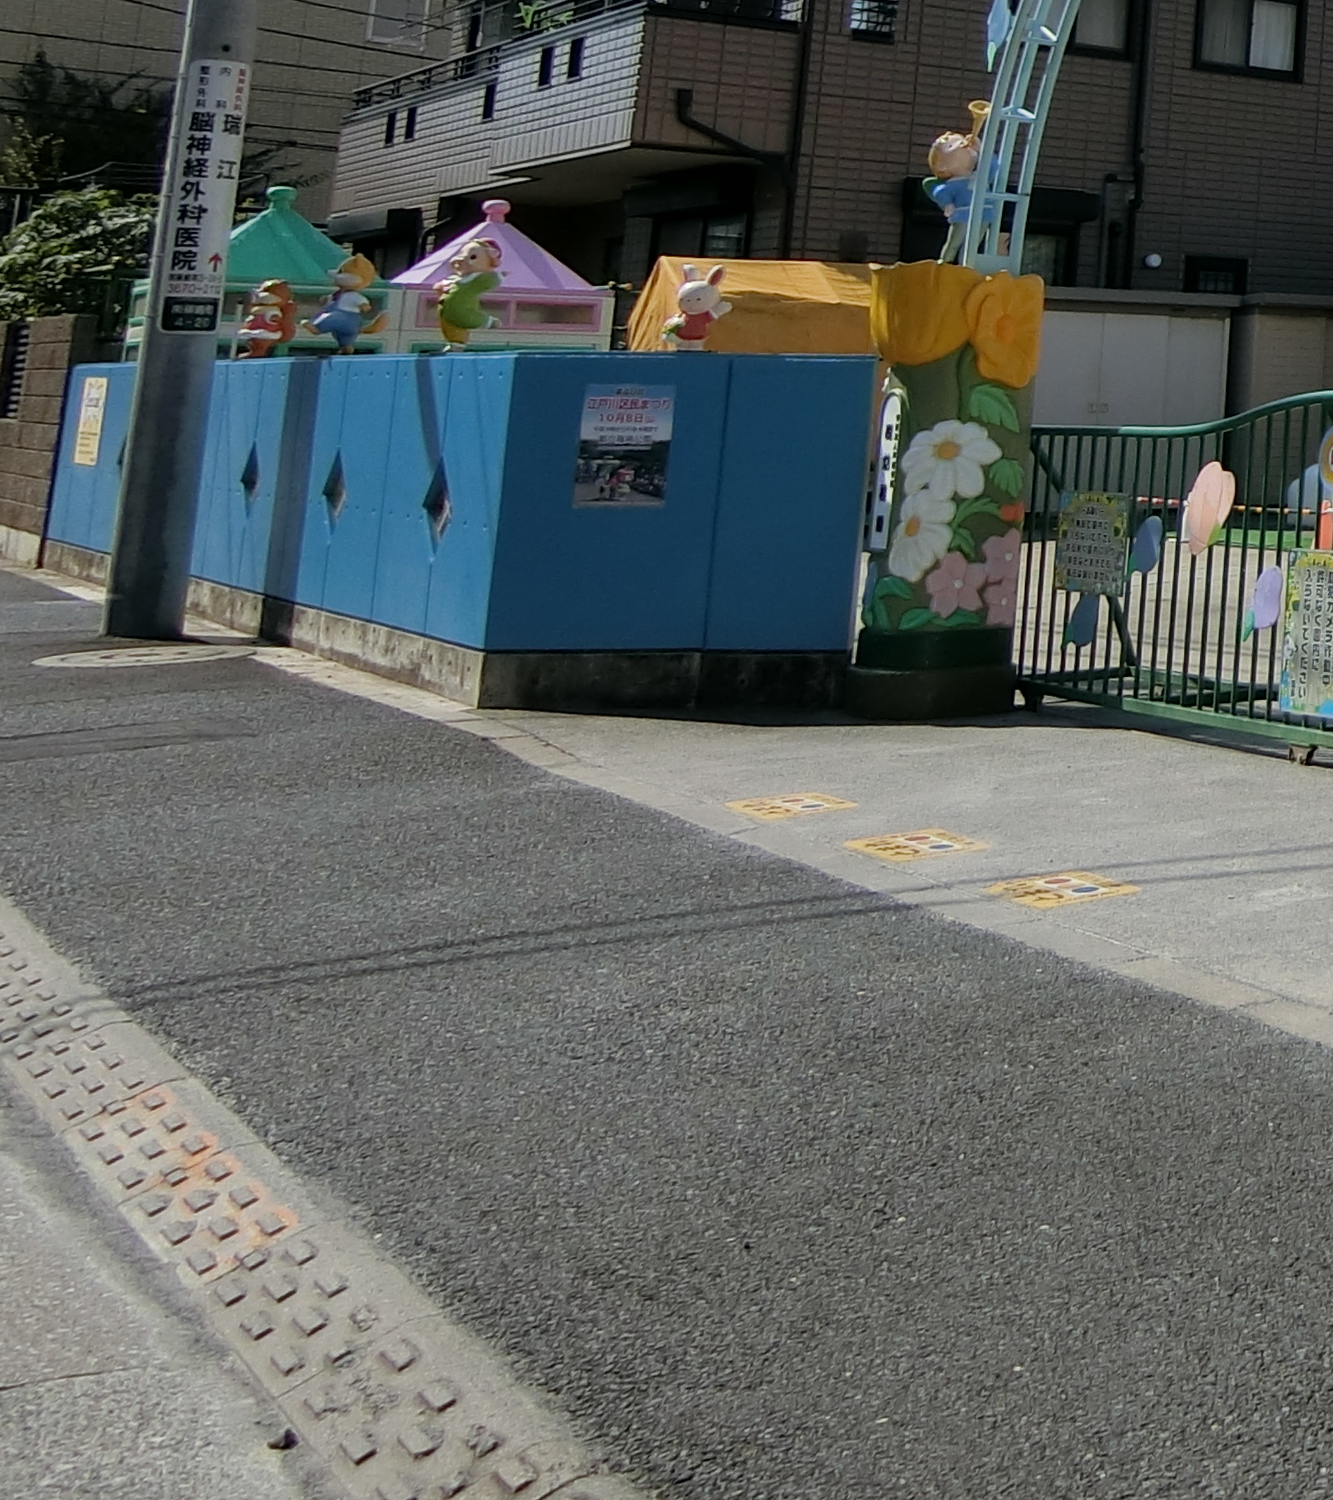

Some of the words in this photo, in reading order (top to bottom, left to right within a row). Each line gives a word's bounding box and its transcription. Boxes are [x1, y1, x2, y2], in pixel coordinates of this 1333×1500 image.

[215, 112, 243, 181] 瑞江
[170, 111, 217, 272] 脳神経外科医院
[587, 398, 671, 410] 江戸川区民まつり
